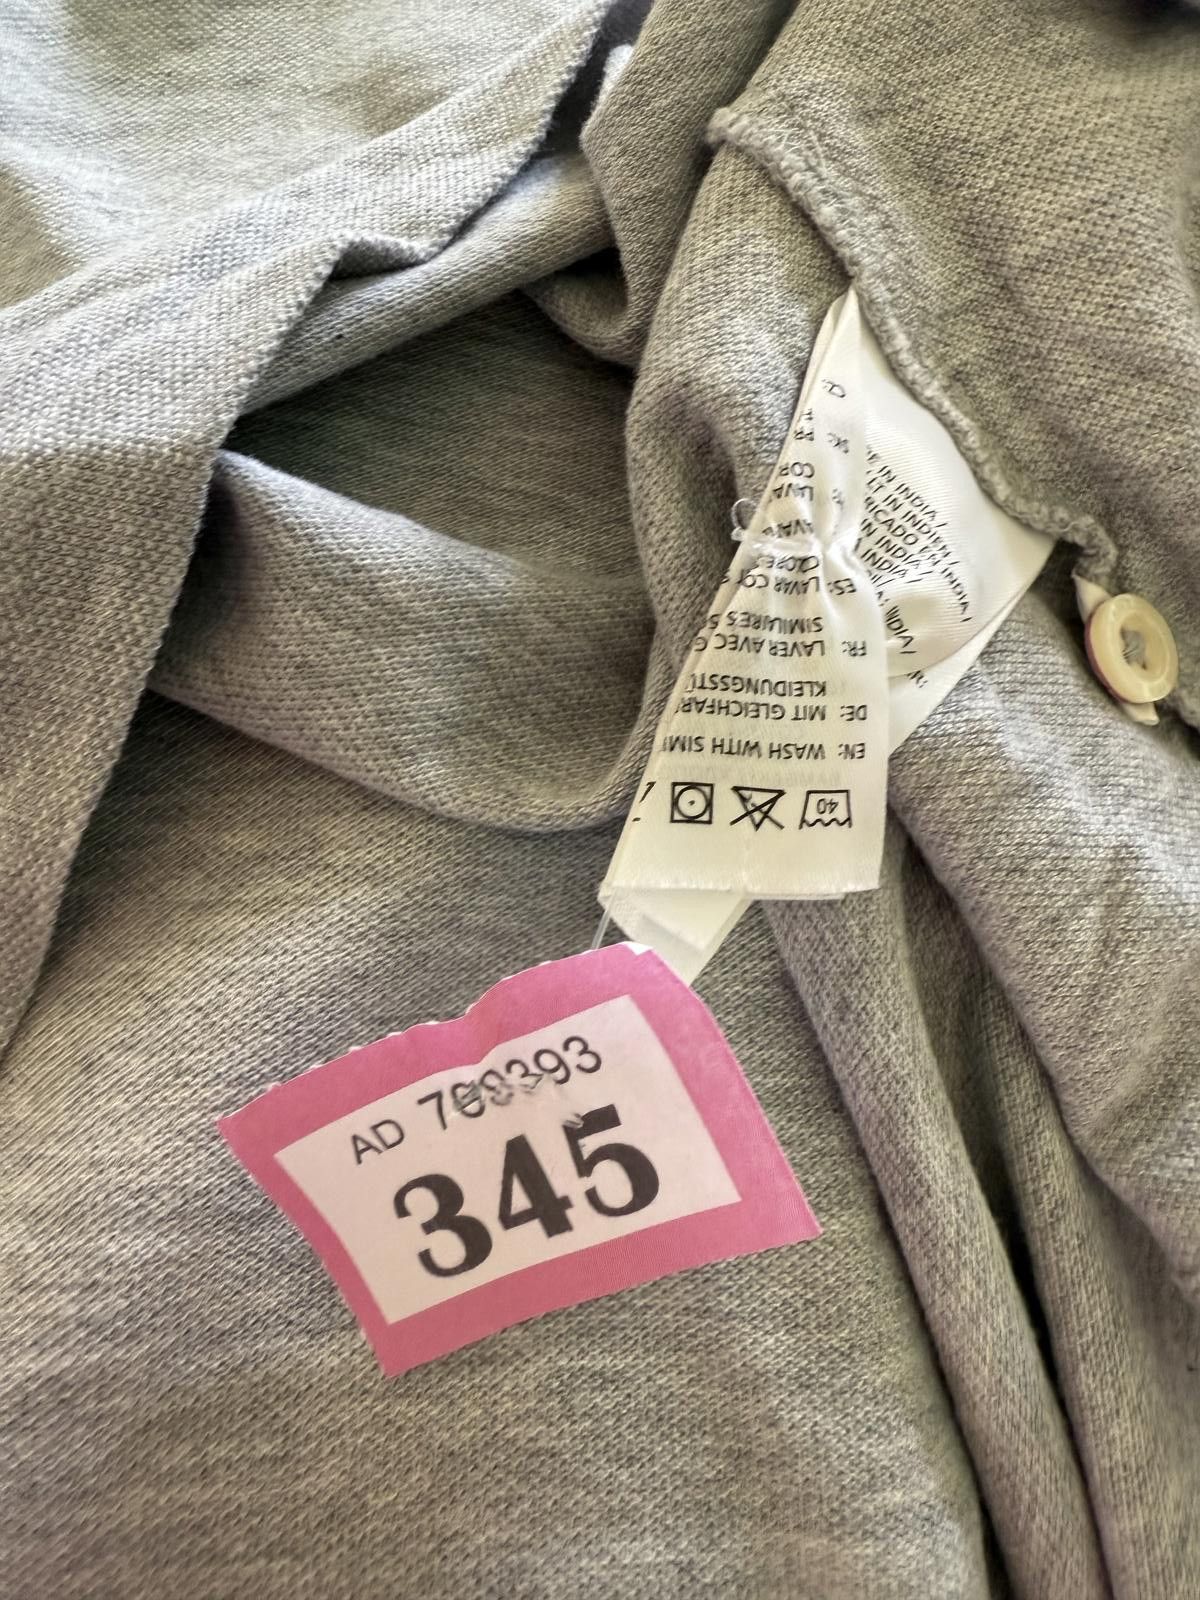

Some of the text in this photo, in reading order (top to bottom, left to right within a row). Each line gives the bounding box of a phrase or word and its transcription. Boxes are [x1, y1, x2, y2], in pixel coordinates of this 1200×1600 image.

[882, 494, 903, 512] IN
[894, 483, 938, 521] INDIA
[875, 535, 921, 569] INDIA
[860, 550, 908, 577] INDIA
[827, 577, 857, 597] ES:
[940, 568, 970, 615] INDIA
[713, 633, 765, 653] AVEC
[769, 640, 826, 658] LAVER
[841, 640, 867, 657] FR:
[675, 697, 867, 721] DE: MIT GLEICHFAR
[711, 737, 762, 759] WITH
[769, 742, 826, 760] WASH
[838, 743, 866, 759] EN:
[816, 798, 839, 814] 40
[350, 1118, 406, 1165] AD
[393, 1103, 660, 1278] 345
